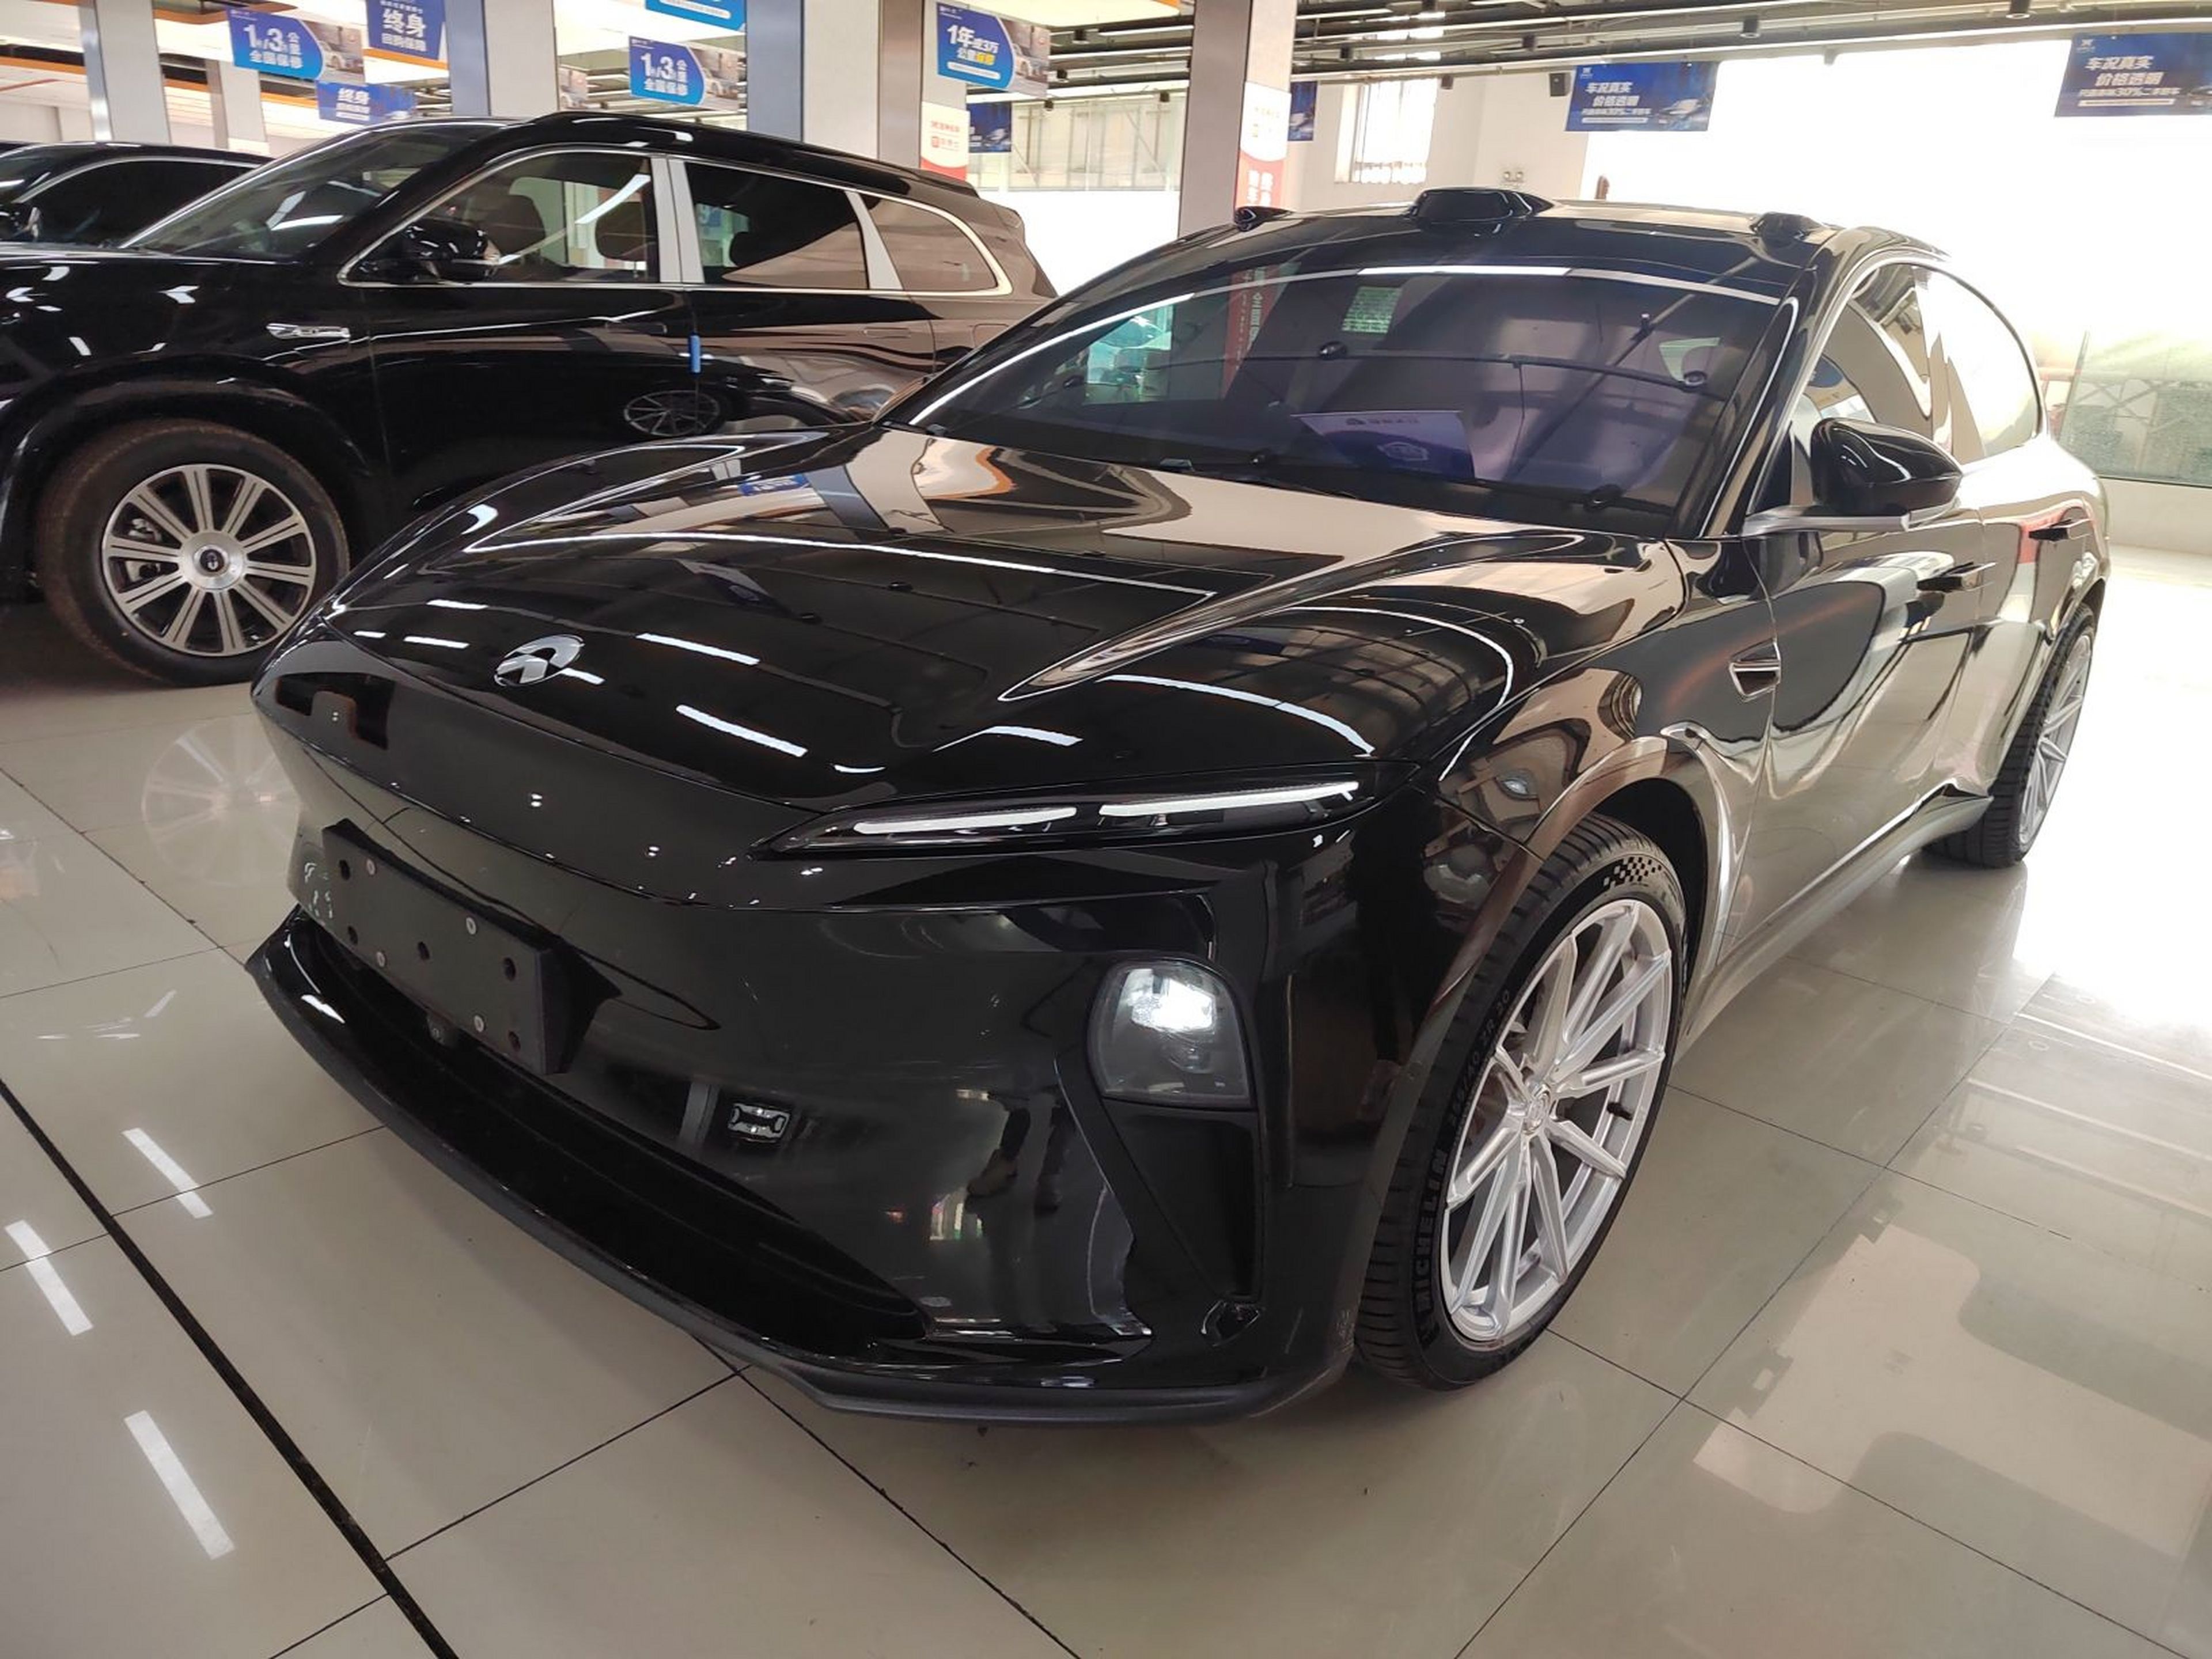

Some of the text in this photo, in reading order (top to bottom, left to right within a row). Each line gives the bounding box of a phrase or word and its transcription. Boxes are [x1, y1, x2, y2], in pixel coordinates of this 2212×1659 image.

[382, 8, 427, 38] 终身
[2084, 55, 2155, 70] 车况真实
[2094, 71, 2165, 86] 价格透明
[1585, 81, 1634, 94] 车况真实
[1414, 1148, 1449, 1314] MICHELIN
